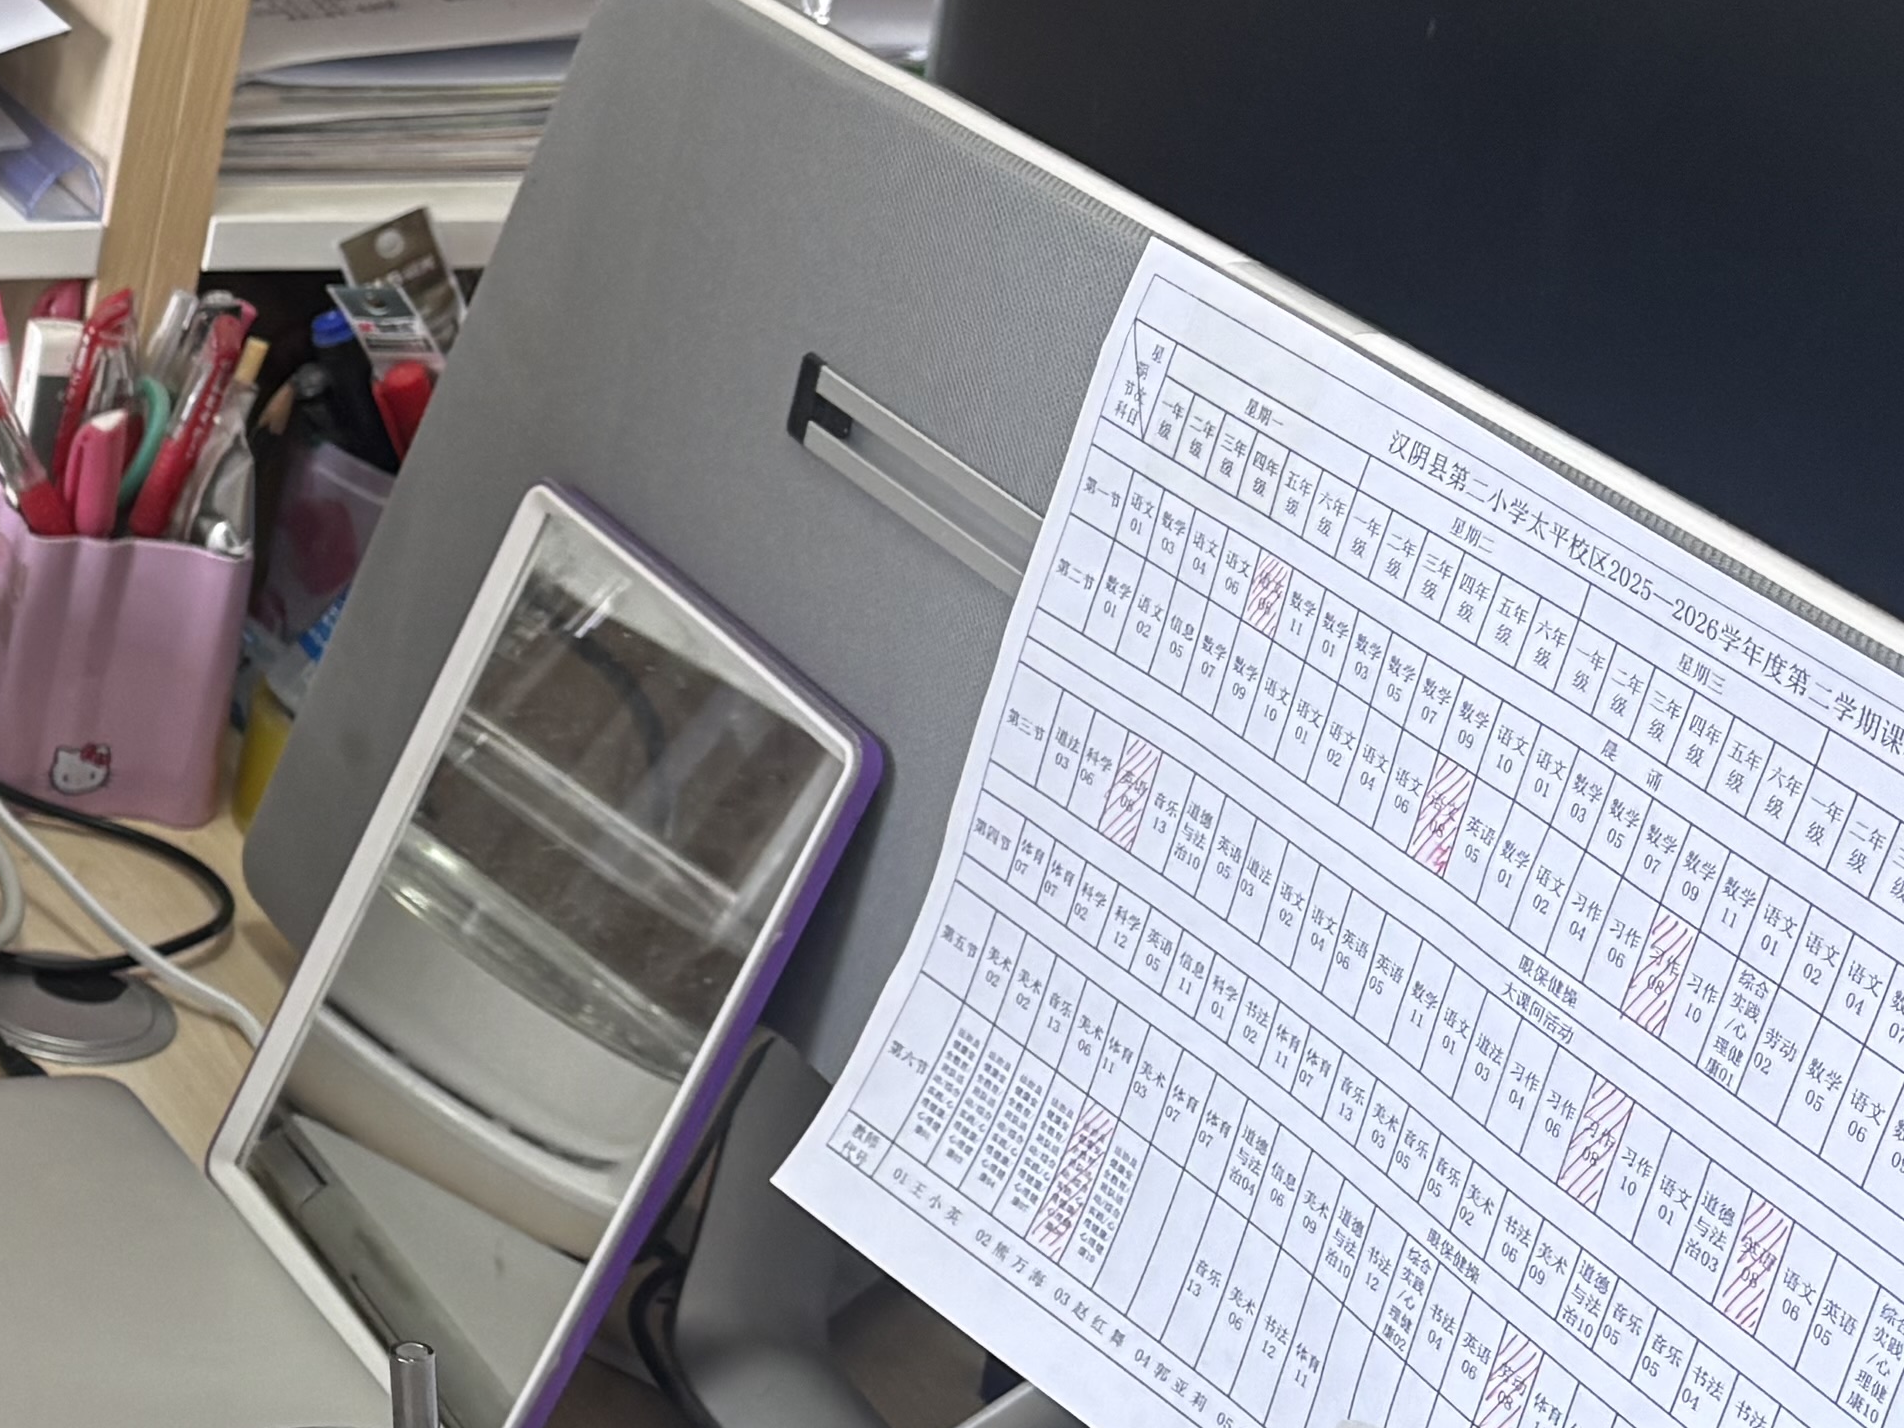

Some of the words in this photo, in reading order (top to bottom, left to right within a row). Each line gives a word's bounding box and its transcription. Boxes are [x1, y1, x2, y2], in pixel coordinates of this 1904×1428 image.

[1161, 400, 1185, 421] 一年
[1243, 397, 1284, 427] 星期一
[1157, 419, 1173, 441] 级
[1220, 433, 1248, 459] 三年
[1219, 457, 1235, 479] 级
[1083, 475, 1121, 509] 第一节
[1130, 491, 1155, 519] 语文
[1317, 491, 1347, 517] 六年
[1129, 517, 1143, 536] 01
[1161, 510, 1187, 537] 数学
[1316, 515, 1333, 538] 级
[1449, 516, 1495, 554] 星期二
[1161, 536, 1175, 555] 03
[1137, 593, 1165, 623] 语文
[1135, 619, 1152, 639] 02
[1169, 614, 1195, 642] 信息
[1321, 611, 1350, 639] 数学
[1169, 639, 1185, 659] 05
[1321, 639, 1336, 659] 01
[1611, 669, 1645, 696] 二年
[1676, 652, 1727, 696] 星期三
[1458, 700, 1490, 730] 数学
[1609, 693, 1629, 718] 级
[1457, 729, 1475, 750] 09
[1687, 713, 1723, 747] 四年
[1685, 743, 1705, 769] 级
[1727, 739, 1763, 772] 五年
[1725, 769, 1745, 795] 级
[1608, 797, 1641, 829] 数学
[1465, 815, 1497, 847] 英语
[1605, 827, 1626, 849] 05
[1464, 843, 1481, 864] 05
[1721, 875, 1757, 909] 数学
[1571, 891, 1603, 923] 习作
[1720, 907, 1738, 929] 11
[1568, 919, 1587, 943] 04
[1805, 930, 1841, 969] 语文
[1802, 962, 1823, 987] 02
[1685, 972, 1719, 1005] 习作
[1684, 1002, 1703, 1024] 10
[1762, 1027, 1798, 1063] 劳动
[1753, 1051, 1773, 1076] 02
[1805, 1057, 1843, 1092] 数学
[1804, 1089, 1825, 1113] 05
[893, 1168, 908, 1184] 01
[976, 1230, 992, 1247] 02
[1054, 1288, 1070, 1306] 03
[1134, 1349, 1150, 1368] 04
